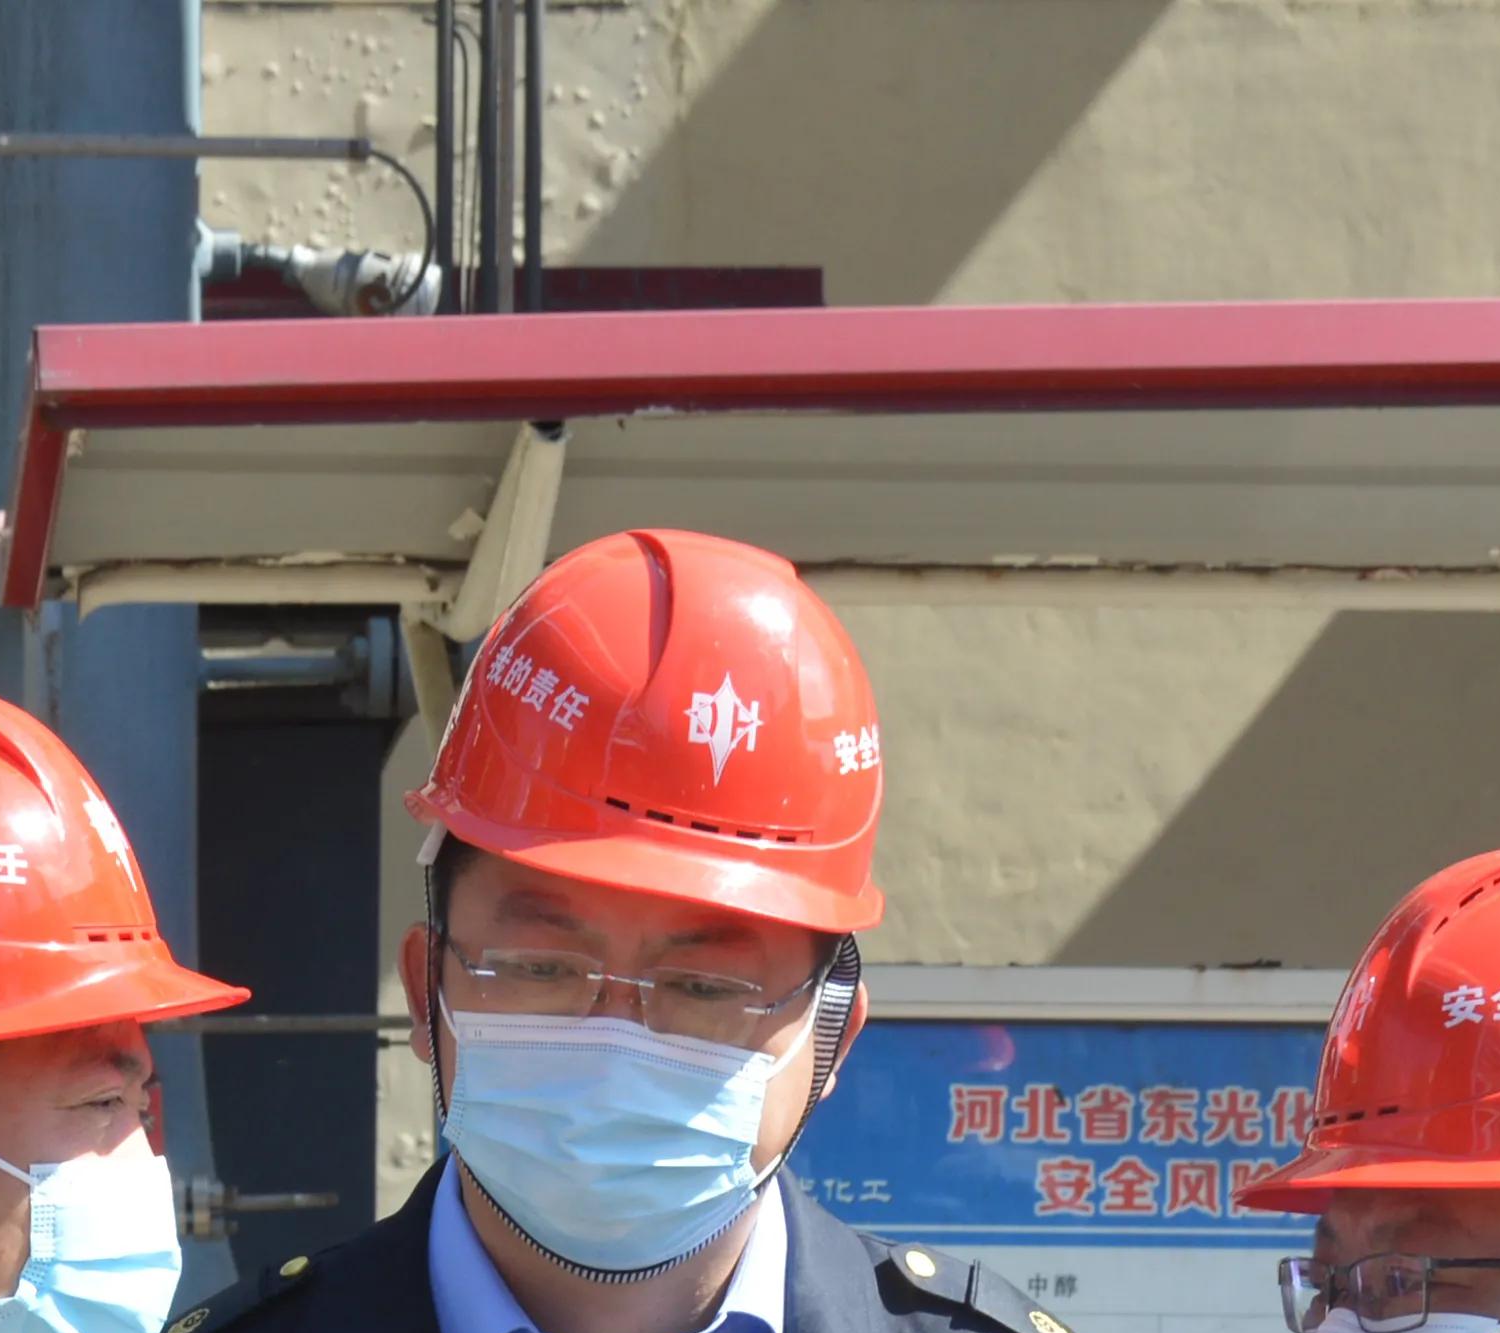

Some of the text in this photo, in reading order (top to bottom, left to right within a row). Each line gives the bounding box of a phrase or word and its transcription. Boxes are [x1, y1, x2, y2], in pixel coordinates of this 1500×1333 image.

[486, 644, 590, 732] 我的责任
[1026, 1273, 1080, 1300] 中醇
